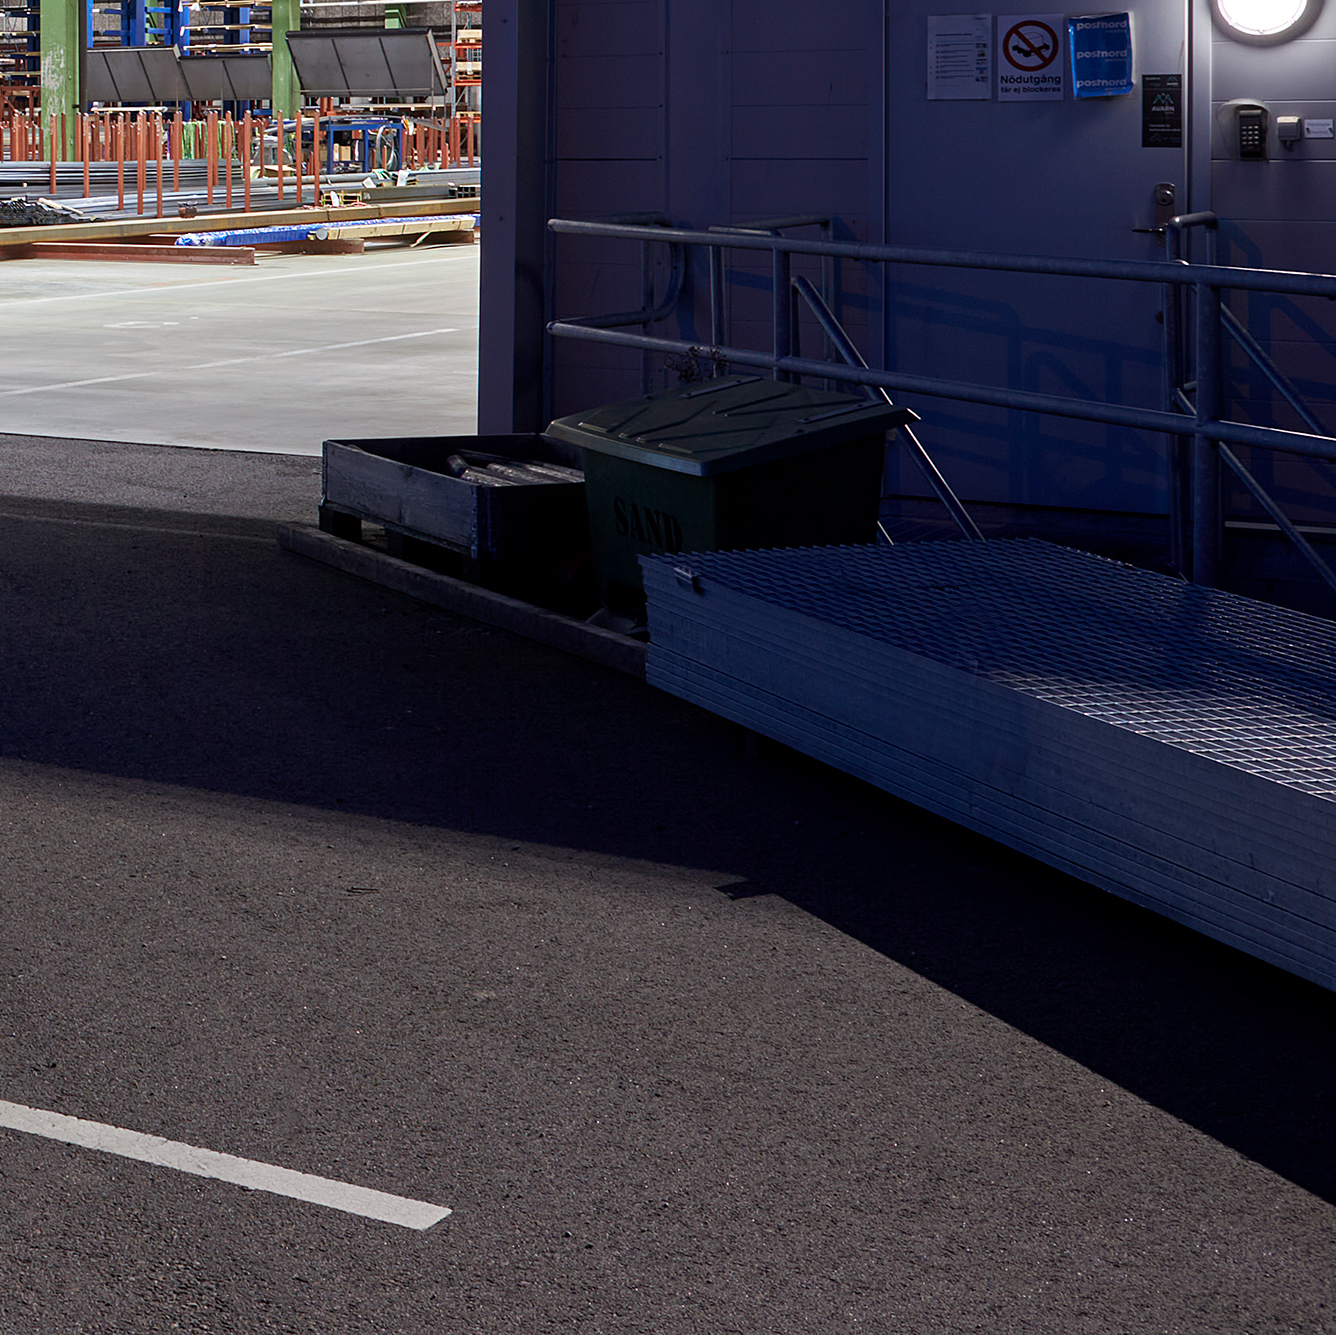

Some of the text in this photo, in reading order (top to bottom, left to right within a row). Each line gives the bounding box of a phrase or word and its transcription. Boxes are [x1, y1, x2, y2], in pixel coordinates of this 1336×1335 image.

[1076, 20, 1127, 31] postnord
[1076, 49, 1127, 60] postnord
[1000, 74, 1061, 85] Nödutgång
[1076, 78, 1127, 89] postnord
[1013, 86, 1021, 94] ej
[614, 496, 683, 554] SAND
